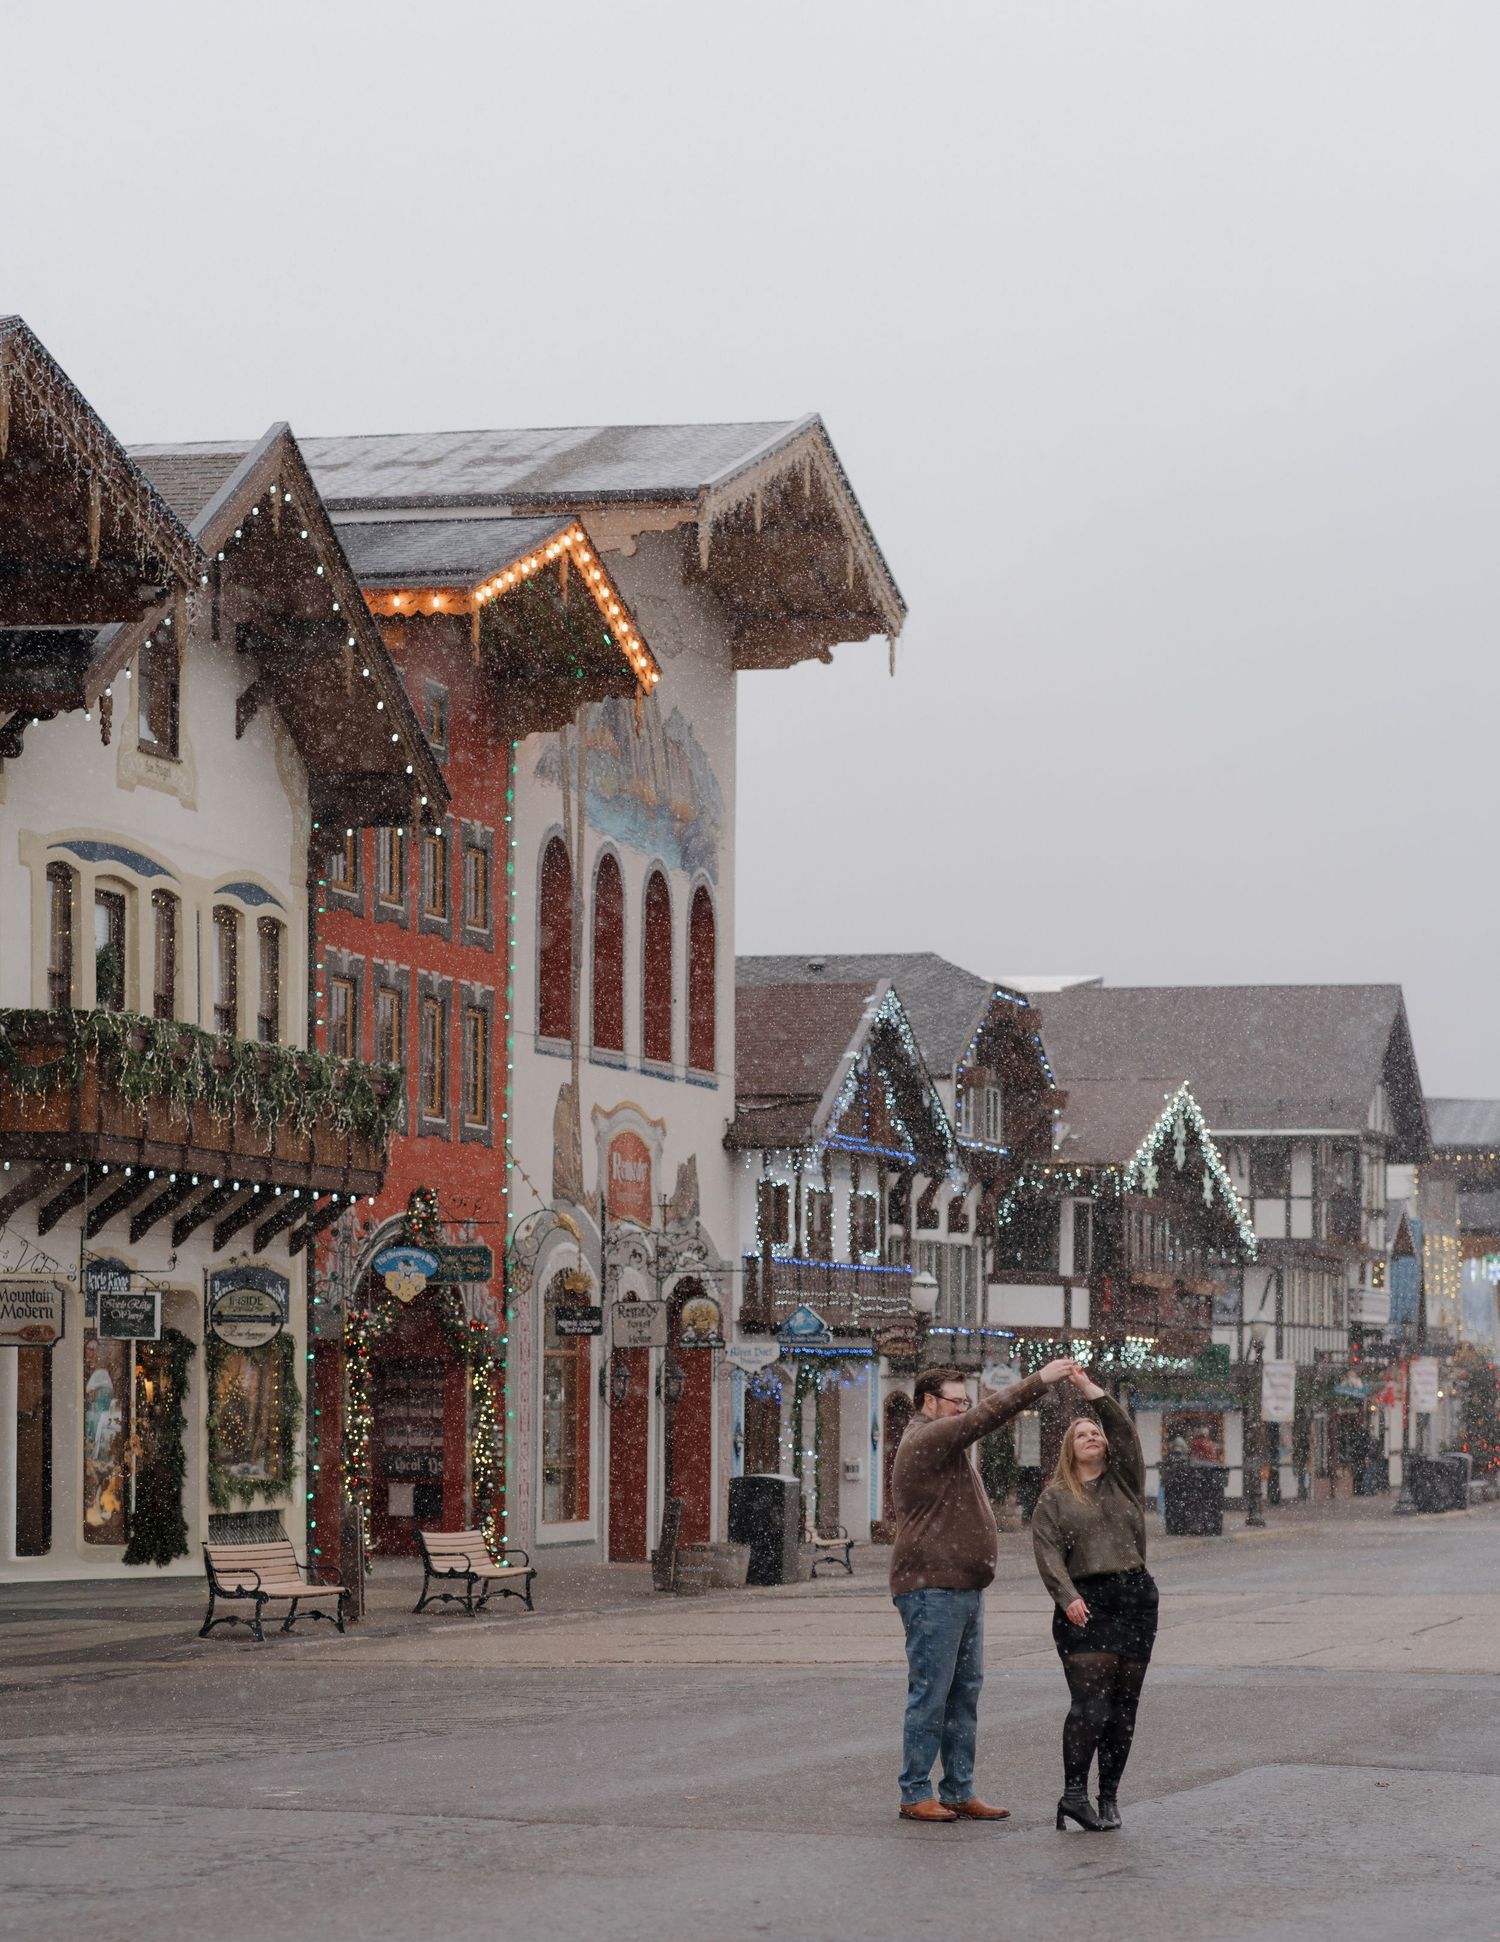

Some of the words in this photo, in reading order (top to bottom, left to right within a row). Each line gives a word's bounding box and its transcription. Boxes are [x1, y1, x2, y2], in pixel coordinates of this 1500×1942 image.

[0, 1288, 54, 1303] Mountain
[1, 1303, 53, 1319] Modern
[619, 1304, 659, 1320] Remedy
